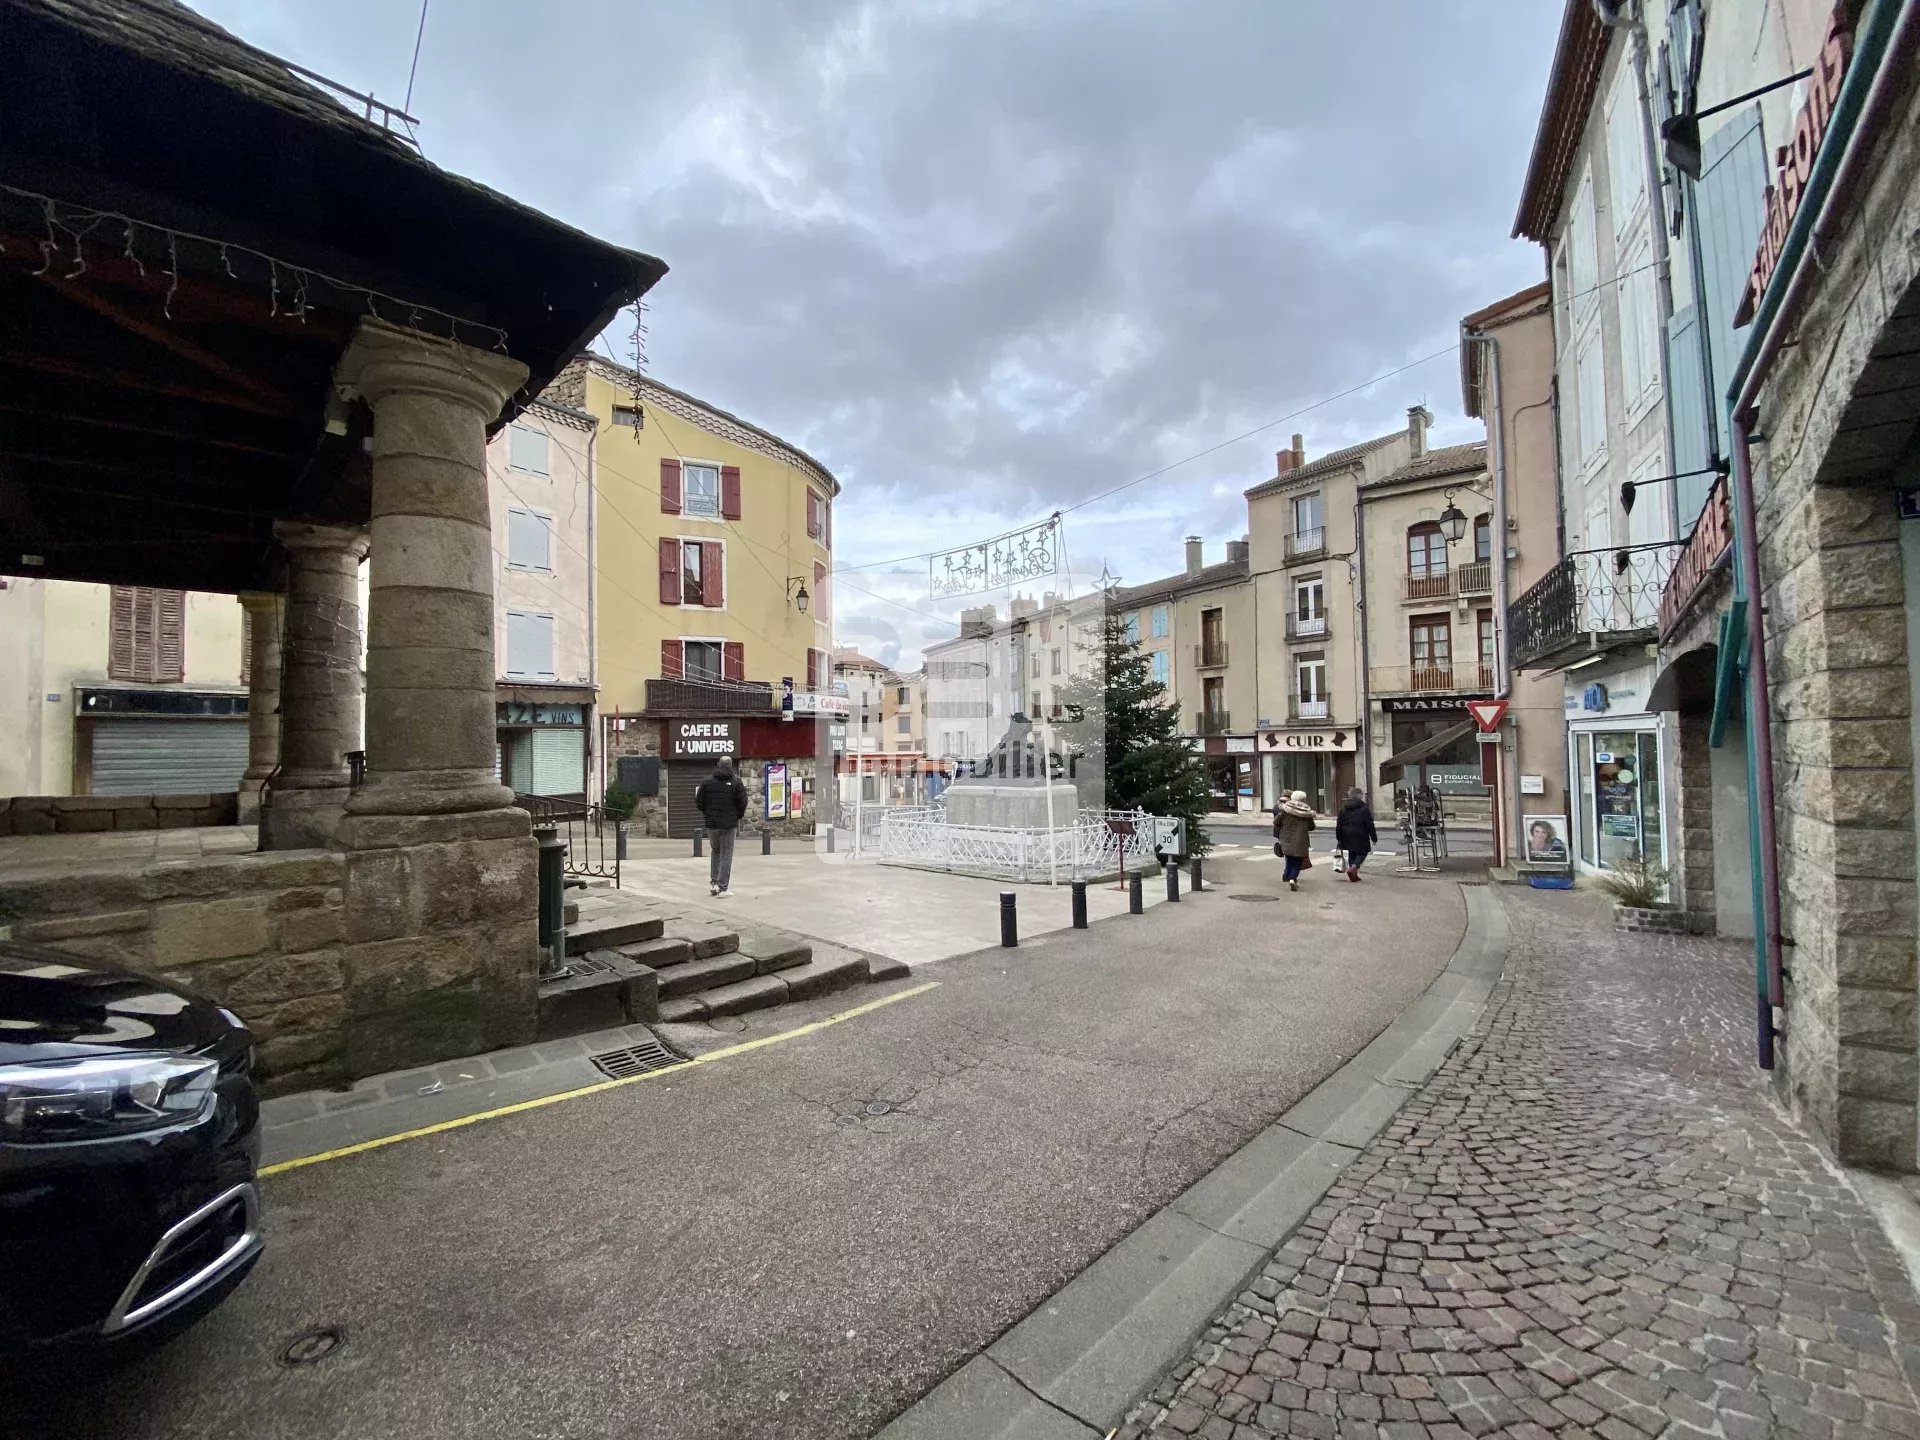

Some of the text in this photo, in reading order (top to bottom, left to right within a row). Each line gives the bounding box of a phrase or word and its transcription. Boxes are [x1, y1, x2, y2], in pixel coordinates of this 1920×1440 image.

[1393, 700, 1468, 710] MAISO
[551, 712, 576, 724] VINS
[680, 724, 729, 737] CAFE DE
[1286, 735, 1324, 747] CUIR
[1162, 835, 1172, 844] 30
